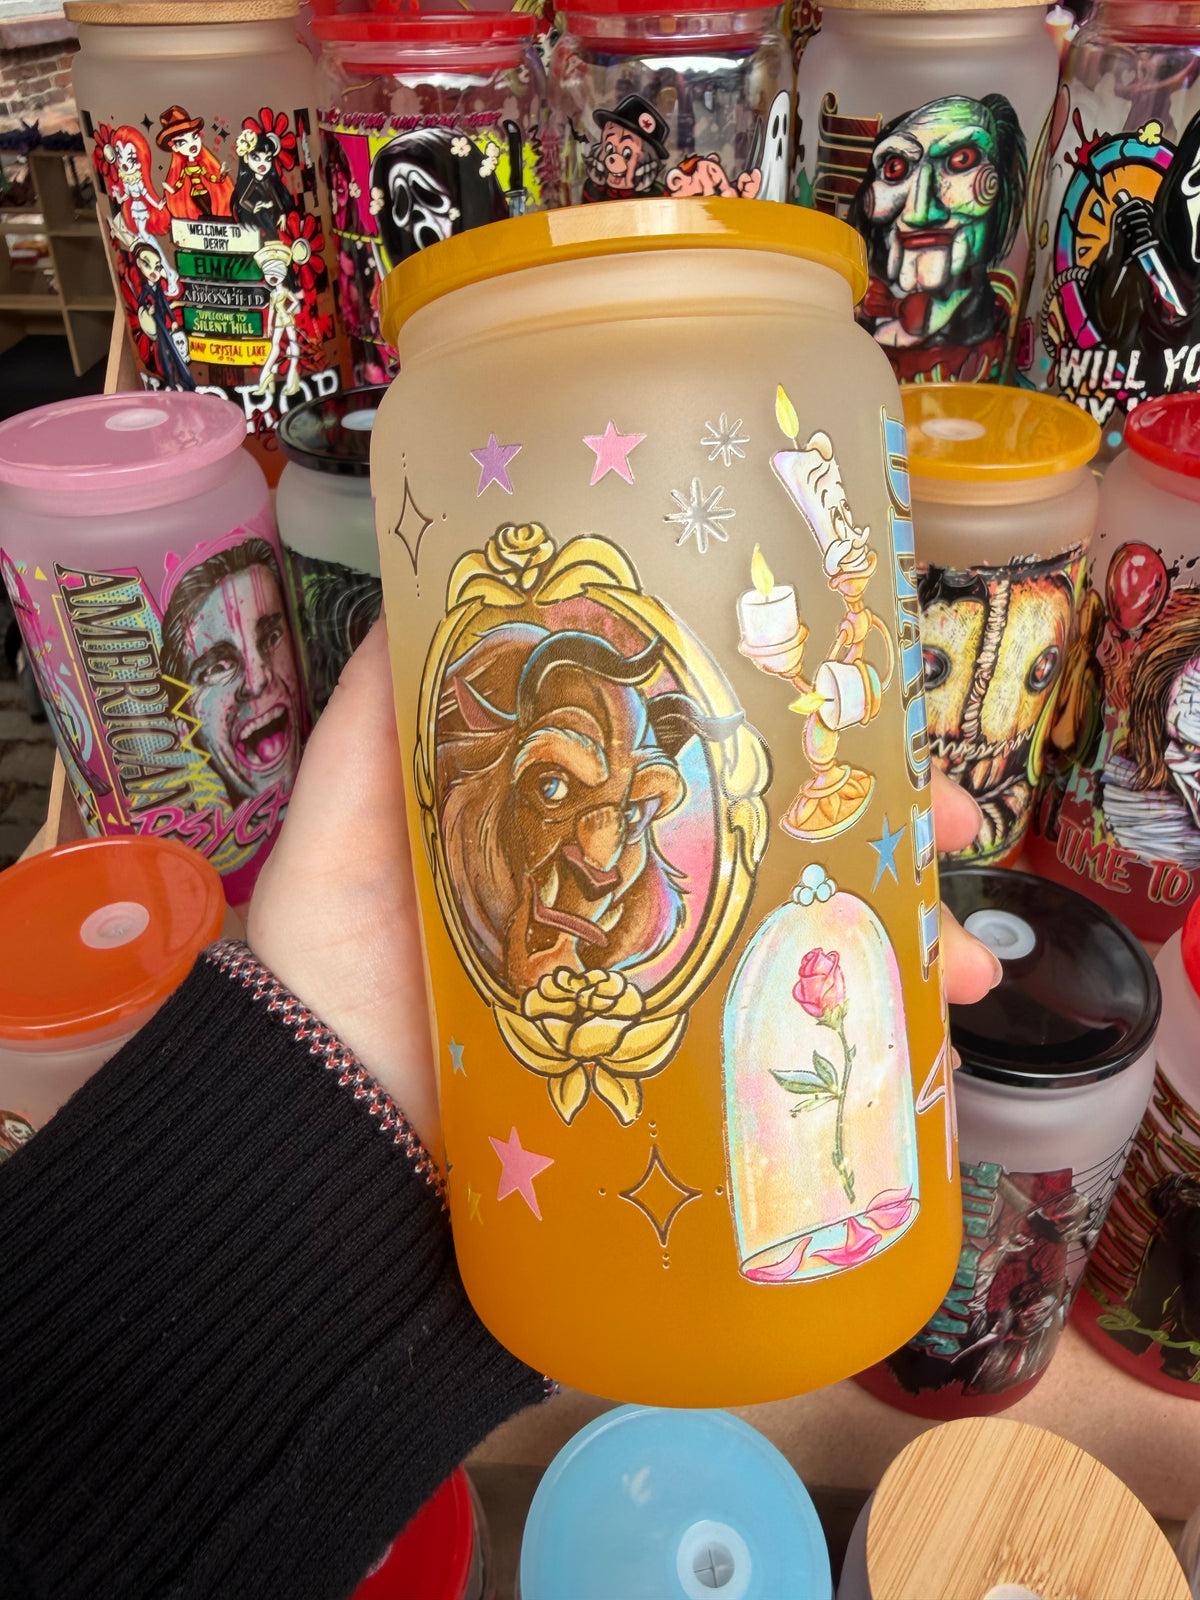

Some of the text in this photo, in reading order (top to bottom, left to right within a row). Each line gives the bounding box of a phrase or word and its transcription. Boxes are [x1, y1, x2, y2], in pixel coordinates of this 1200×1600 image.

[187, 223, 242, 239] WELCOME TO
[203, 237, 230, 250] DERRY
[193, 318, 255, 335] SILENT HILL
[209, 343, 242, 357] CRYSTAL
[246, 345, 267, 358] LAKE
[1058, 342, 1200, 393] WILL YO
[53, 561, 196, 813] AMERICAN
[1056, 815, 1194, 906] TIME TO
